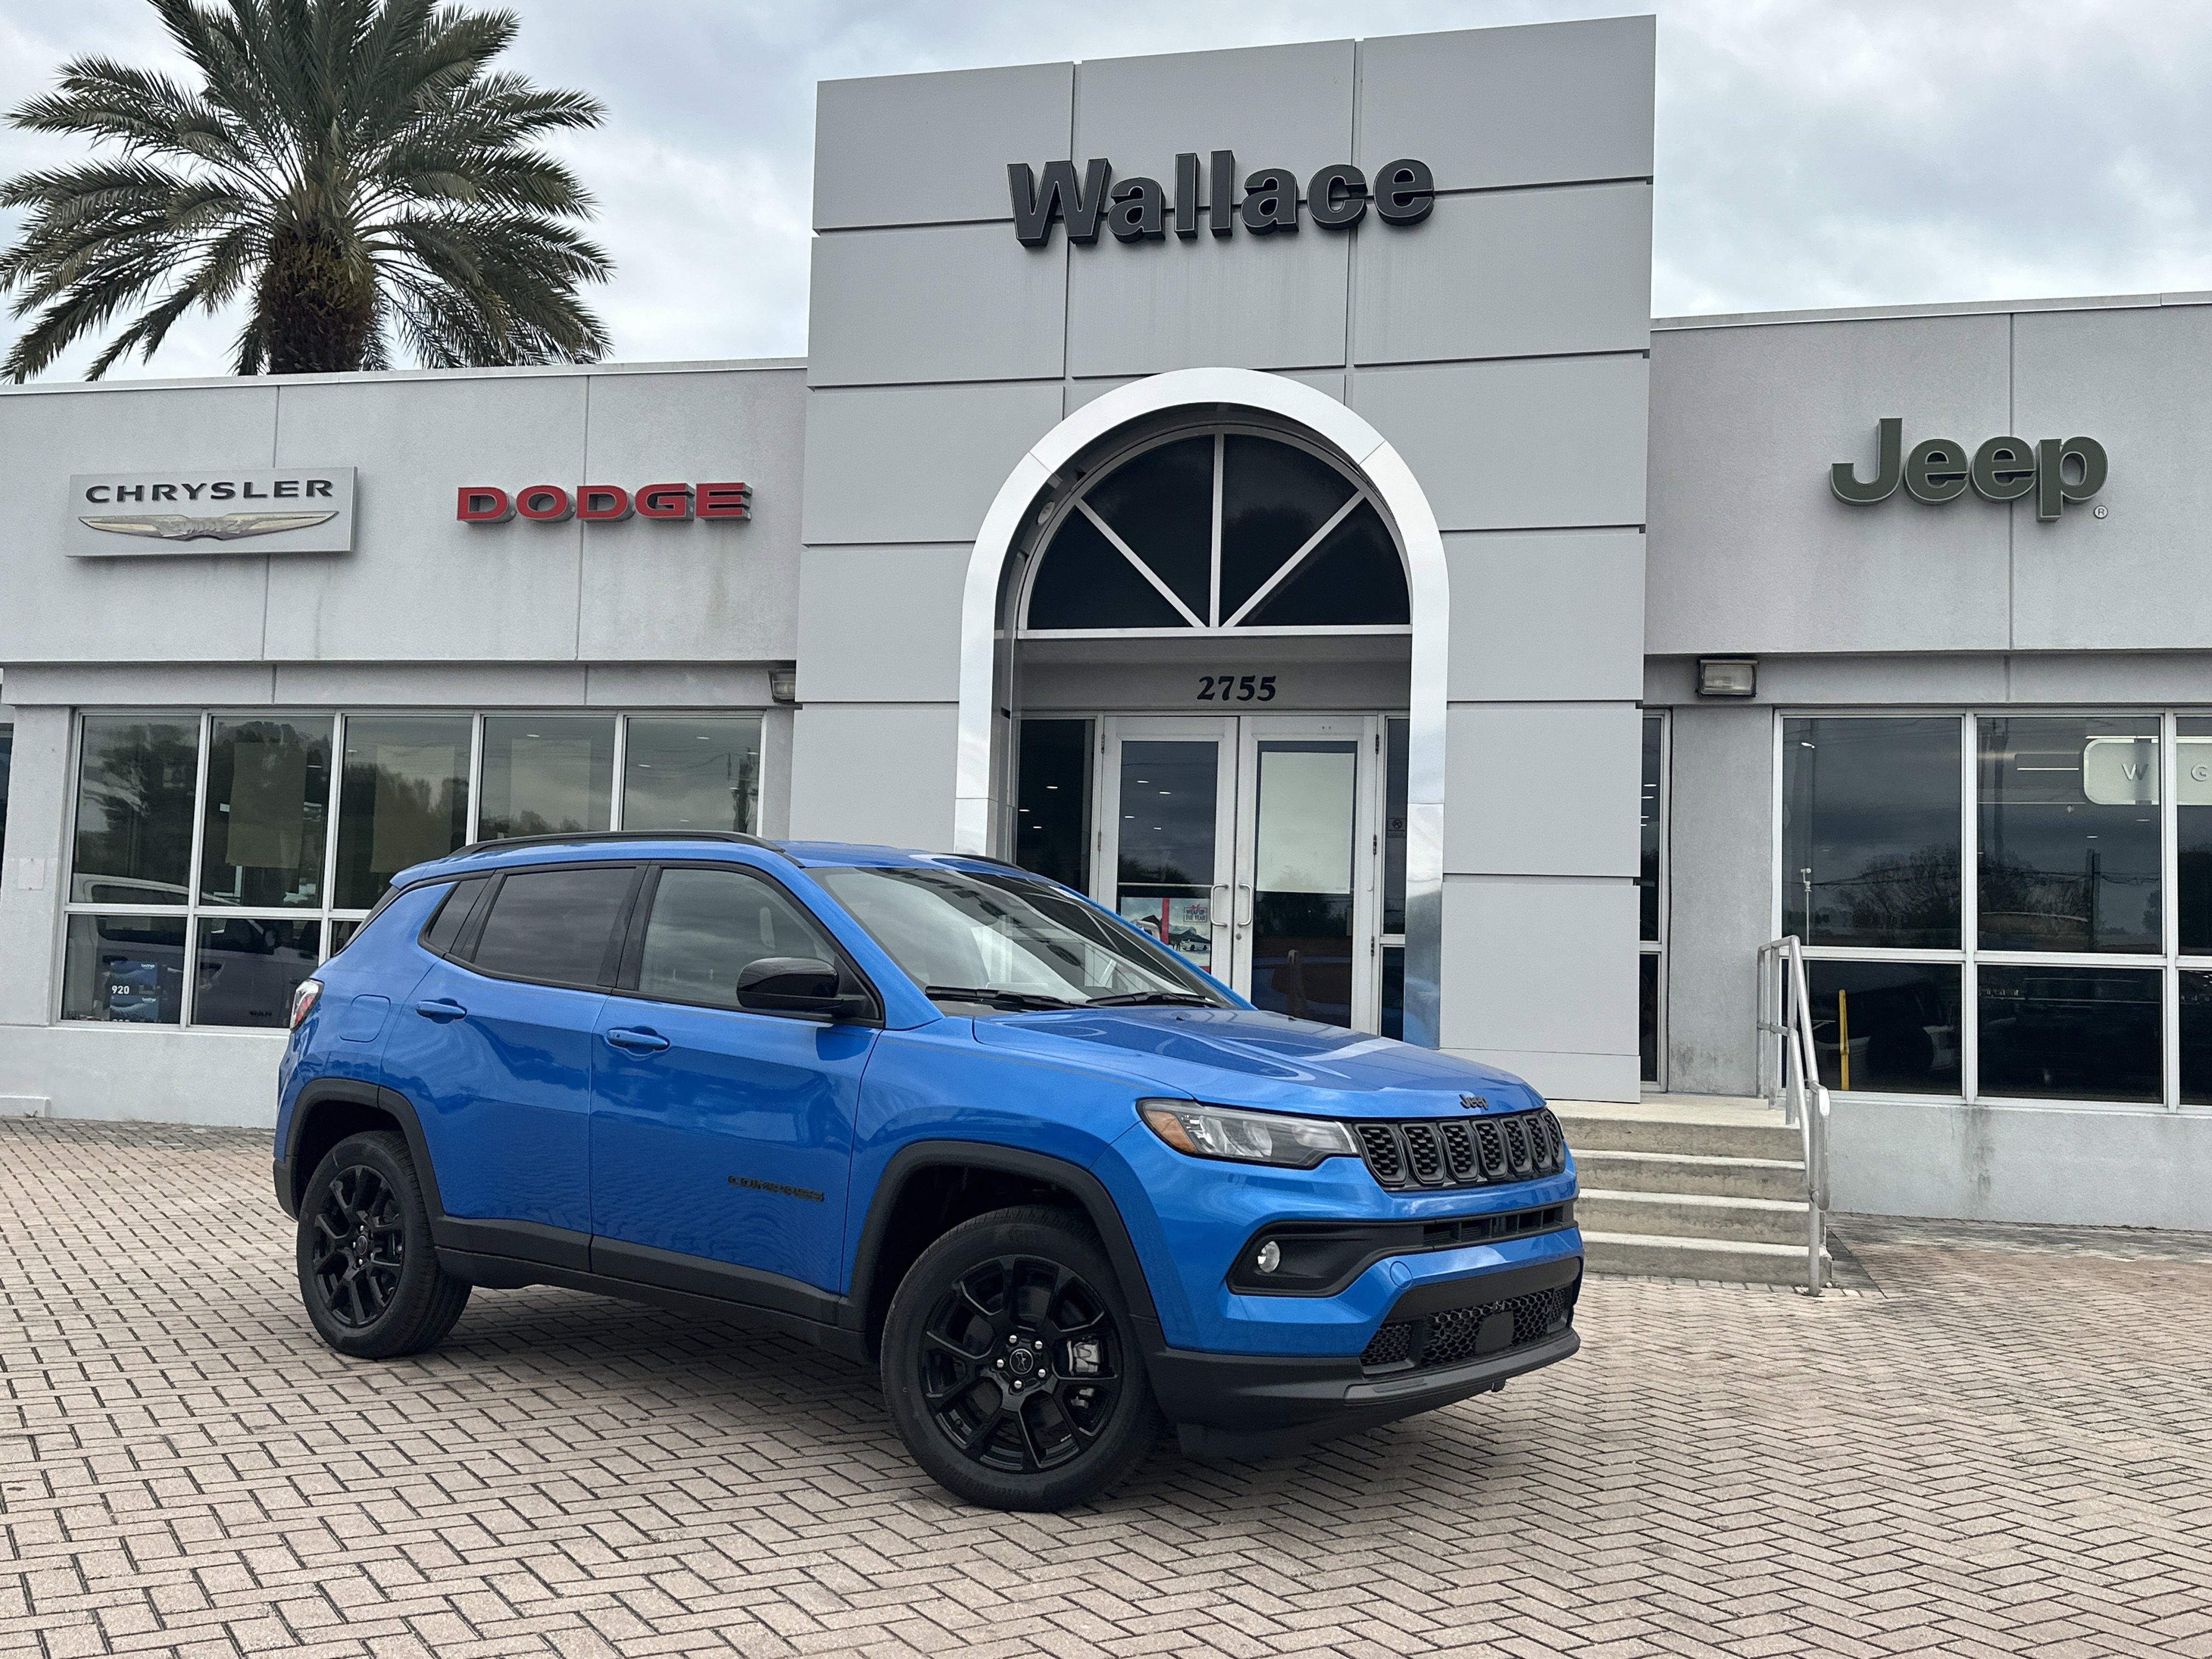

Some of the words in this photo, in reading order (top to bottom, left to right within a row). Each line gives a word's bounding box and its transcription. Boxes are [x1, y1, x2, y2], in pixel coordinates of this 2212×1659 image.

[1007, 150, 1435, 247] Wallace
[1830, 418, 2108, 522] Jeep
[86, 479, 333, 503] CHRYSLER
[457, 482, 752, 522] DODGE
[1197, 675, 1276, 701] 2755
[111, 985, 129, 995] 920
[1459, 1094, 1489, 1110] Jeep
